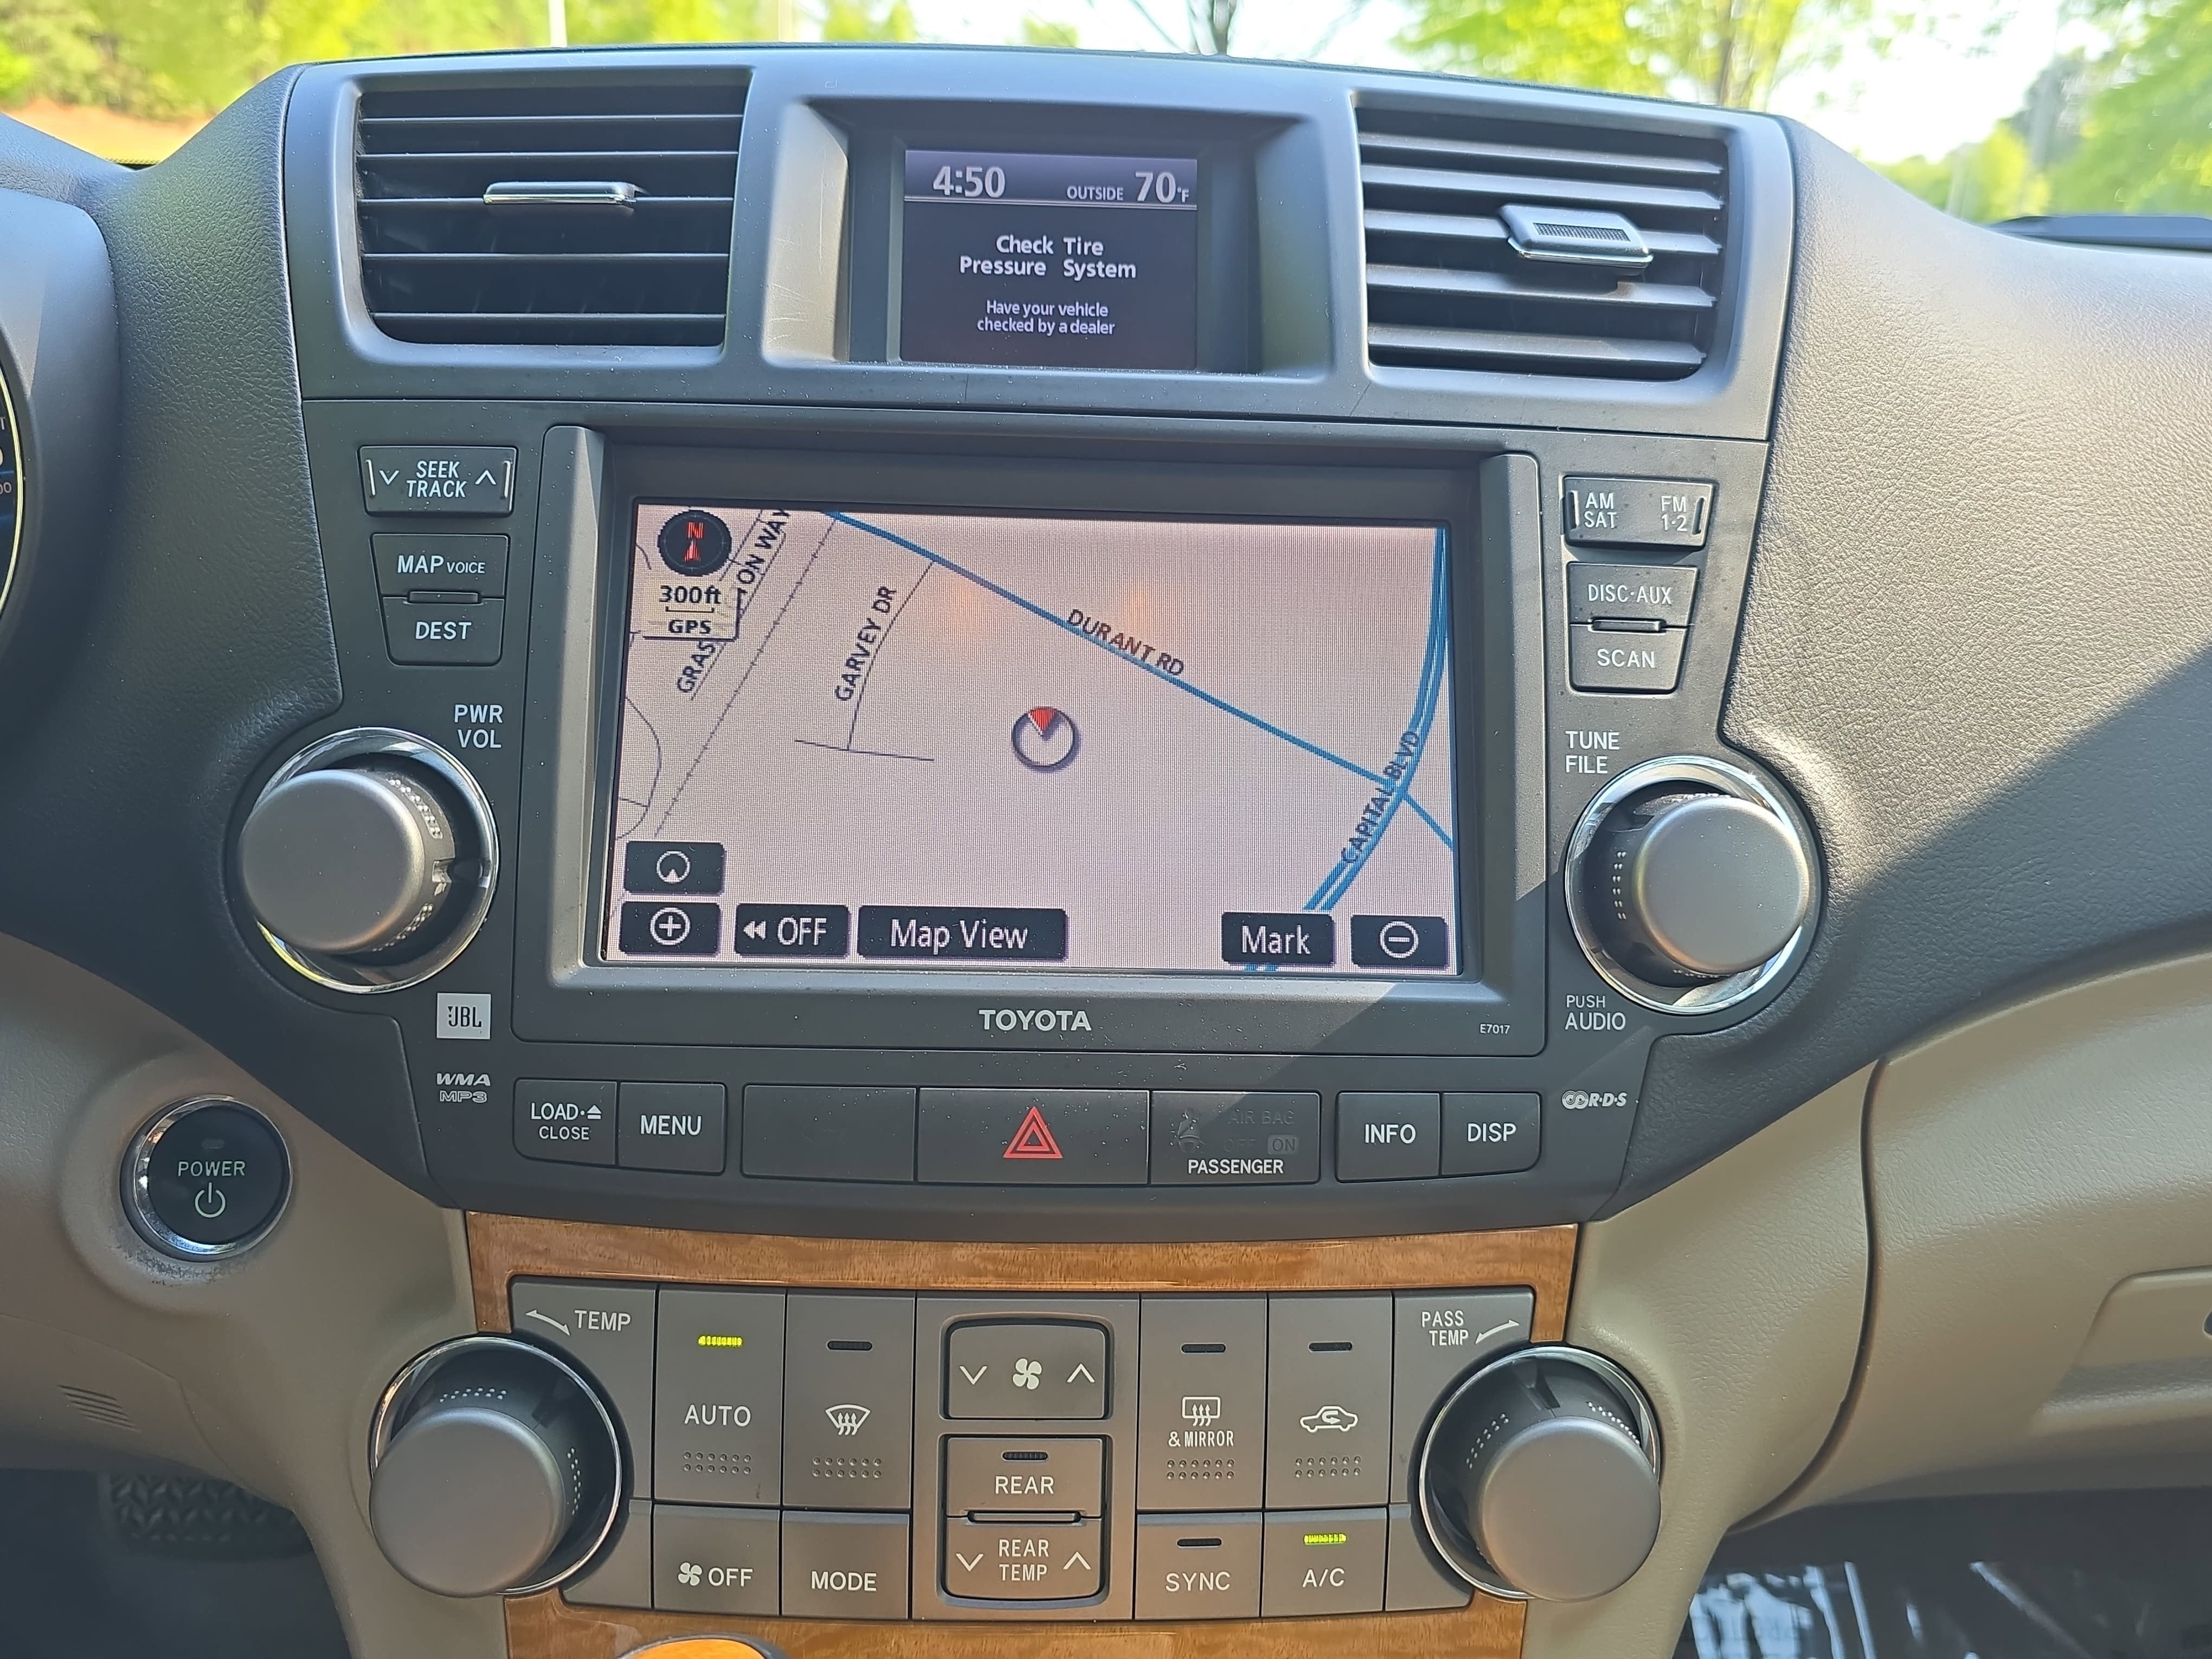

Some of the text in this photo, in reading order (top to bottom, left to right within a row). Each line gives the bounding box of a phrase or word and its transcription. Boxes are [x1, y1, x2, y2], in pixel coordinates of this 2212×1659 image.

[933, 165, 1006, 198] 4:50
[1066, 186, 1124, 201] OUTSIDE
[996, 234, 1104, 256] Check Tire
[960, 256, 1137, 281] Pressure System
[986, 300, 1109, 318] Have your vehicle
[977, 318, 1115, 336] checked by a dealer
[416, 460, 460, 478] SEEK
[406, 480, 467, 498] TRACK
[1585, 492, 1614, 510] AM
[1661, 496, 1687, 512] FM
[754, 509, 790, 549] WAY
[1584, 512, 1618, 529] SAT
[687, 522, 704, 539] N
[397, 555, 486, 574] MAP VOICE
[415, 621, 472, 640] DEST
[668, 619, 711, 634] GPS
[834, 586, 897, 701] GARVEY DR
[1067, 608, 1185, 677] DURANT RD
[1597, 649, 1656, 668] SCAN
[454, 704, 504, 723] PWR
[457, 729, 501, 748] VOL
[1565, 731, 1620, 750] TUNE
[1566, 756, 1608, 774] FILE
[1341, 732, 1419, 863] CAPITAL BLVD
[777, 917, 828, 947] OFF
[890, 919, 1028, 955] Map View
[1240, 925, 1311, 955] Mark
[1566, 995, 1606, 1008] PUSH
[447, 1006, 482, 1028] JBL
[978, 1009, 1092, 1032] TOYOTA
[1564, 1012, 1626, 1031] AUDIO
[1480, 1024, 1510, 1034] E7017
[436, 1073, 492, 1086] WMA
[439, 1090, 488, 1103] MP3
[640, 1115, 702, 1136] MENU
[1262, 1110, 1295, 1125] BAG
[538, 1126, 590, 1141] CLOSE
[1365, 1124, 1417, 1143] INFO
[1467, 1123, 1517, 1142] DISP
[1272, 1138, 1296, 1152] ON
[178, 1161, 246, 1177] POWER
[1188, 1159, 1284, 1174] PASSENGER
[574, 1310, 632, 1332] TEMP
[1422, 1310, 1464, 1328] PASS
[1429, 1329, 1469, 1346] TEMP
[684, 1405, 751, 1427] AUTO
[1168, 1430, 1234, 1447] & MIRROR
[995, 1476, 1054, 1495] REAR
[999, 1539, 1050, 1558] REAR
[708, 1568, 754, 1587] OFF
[811, 1571, 877, 1592] MODE
[999, 1564, 1048, 1582] TEMP
[1165, 1571, 1231, 1592] SYNC
[1302, 1568, 1345, 1589] A/C
